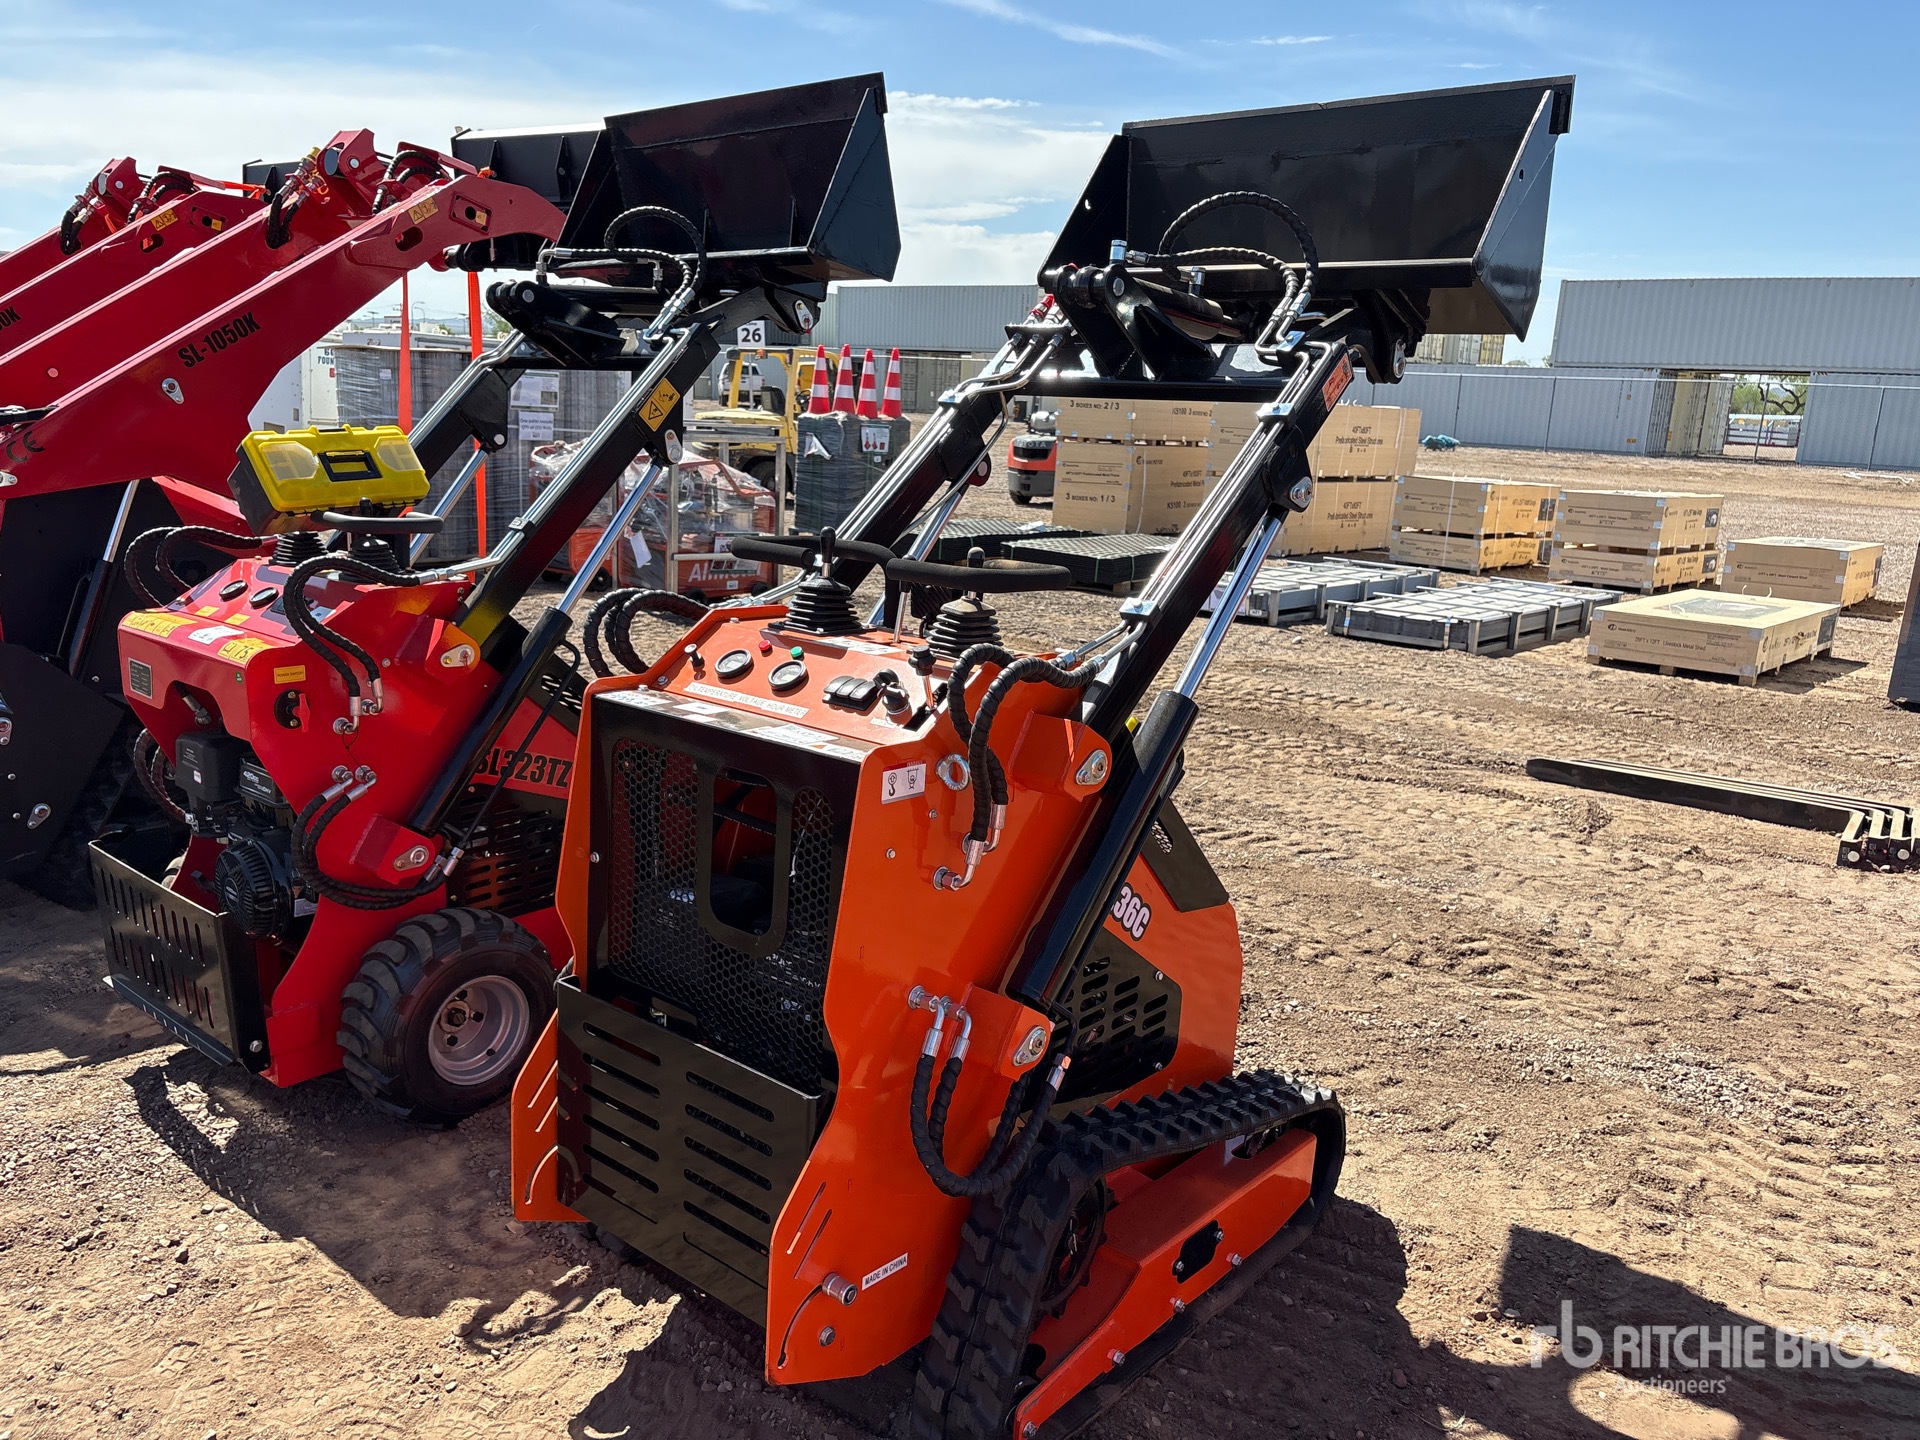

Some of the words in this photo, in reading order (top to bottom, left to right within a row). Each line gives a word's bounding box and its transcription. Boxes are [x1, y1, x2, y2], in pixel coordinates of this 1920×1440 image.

[0, 305, 21, 332] 0K
[177, 310, 261, 369] SL-1050K
[741, 328, 762, 343] 26
[1070, 400, 1074, 408] 3
[1065, 492, 1070, 500] 3
[1662, 640, 1682, 648] Livestock
[700, 685, 738, 700] TEMPERATURE
[738, 694, 766, 708] VOLTAGE
[767, 702, 784, 711] HOUR
[784, 705, 806, 716] METER
[1110, 882, 1152, 941] 36C
[864, 1269, 881, 1286] MADE
[881, 1265, 889, 1276] IN
[888, 1256, 907, 1272] CHINA
